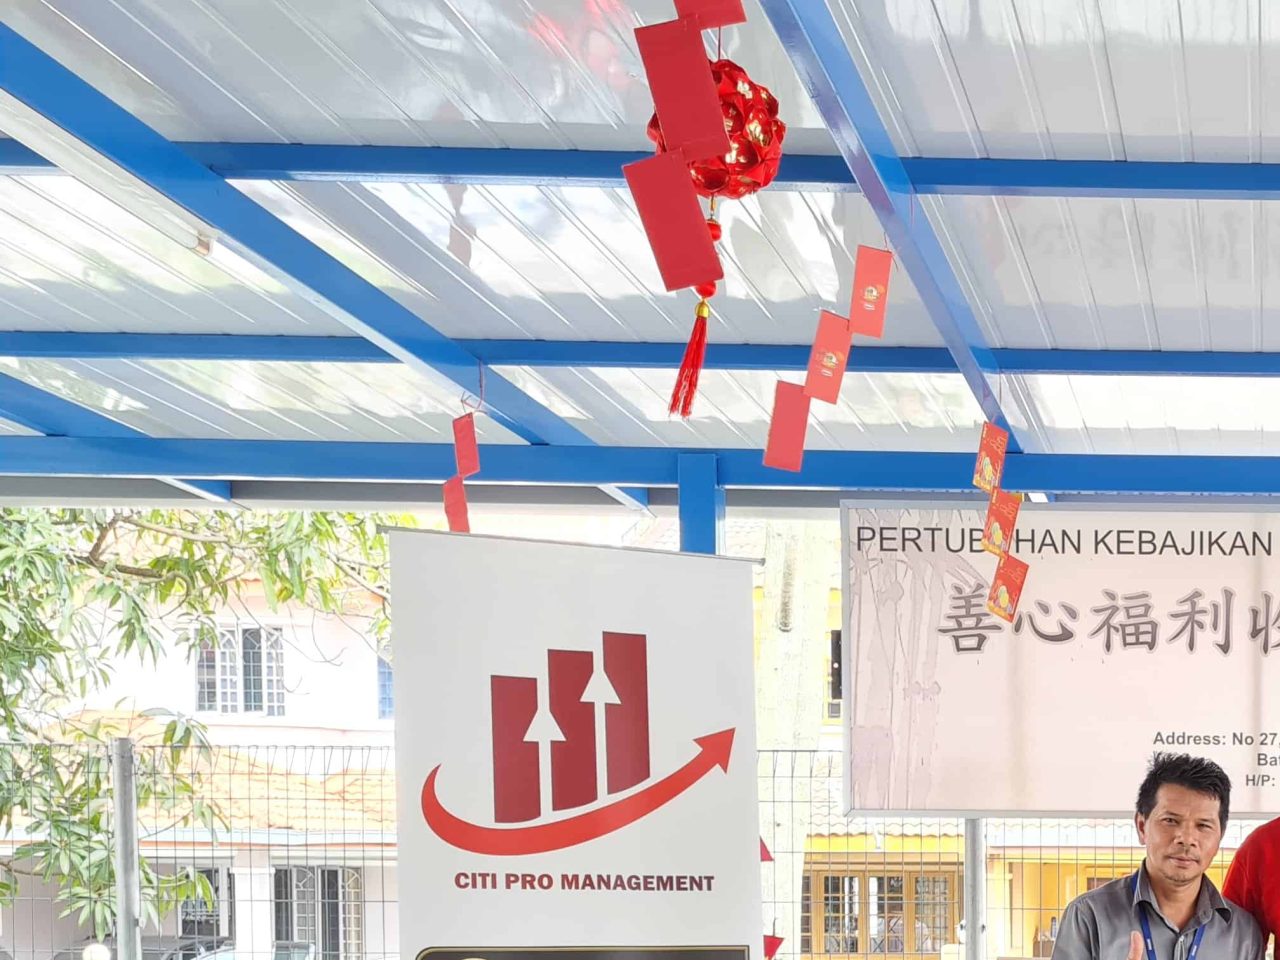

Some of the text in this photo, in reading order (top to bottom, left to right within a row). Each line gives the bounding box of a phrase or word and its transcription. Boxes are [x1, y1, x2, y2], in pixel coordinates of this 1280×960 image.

[856, 526, 1081, 555] PERTUBHAN
[1094, 529, 1272, 557] KEBAJIKAN
[1153, 731, 1226, 746] Address:
[1232, 732, 1254, 746] No
[1245, 774, 1275, 788] H/P:
[454, 872, 715, 892] CITI PRO MANAGEMENT
